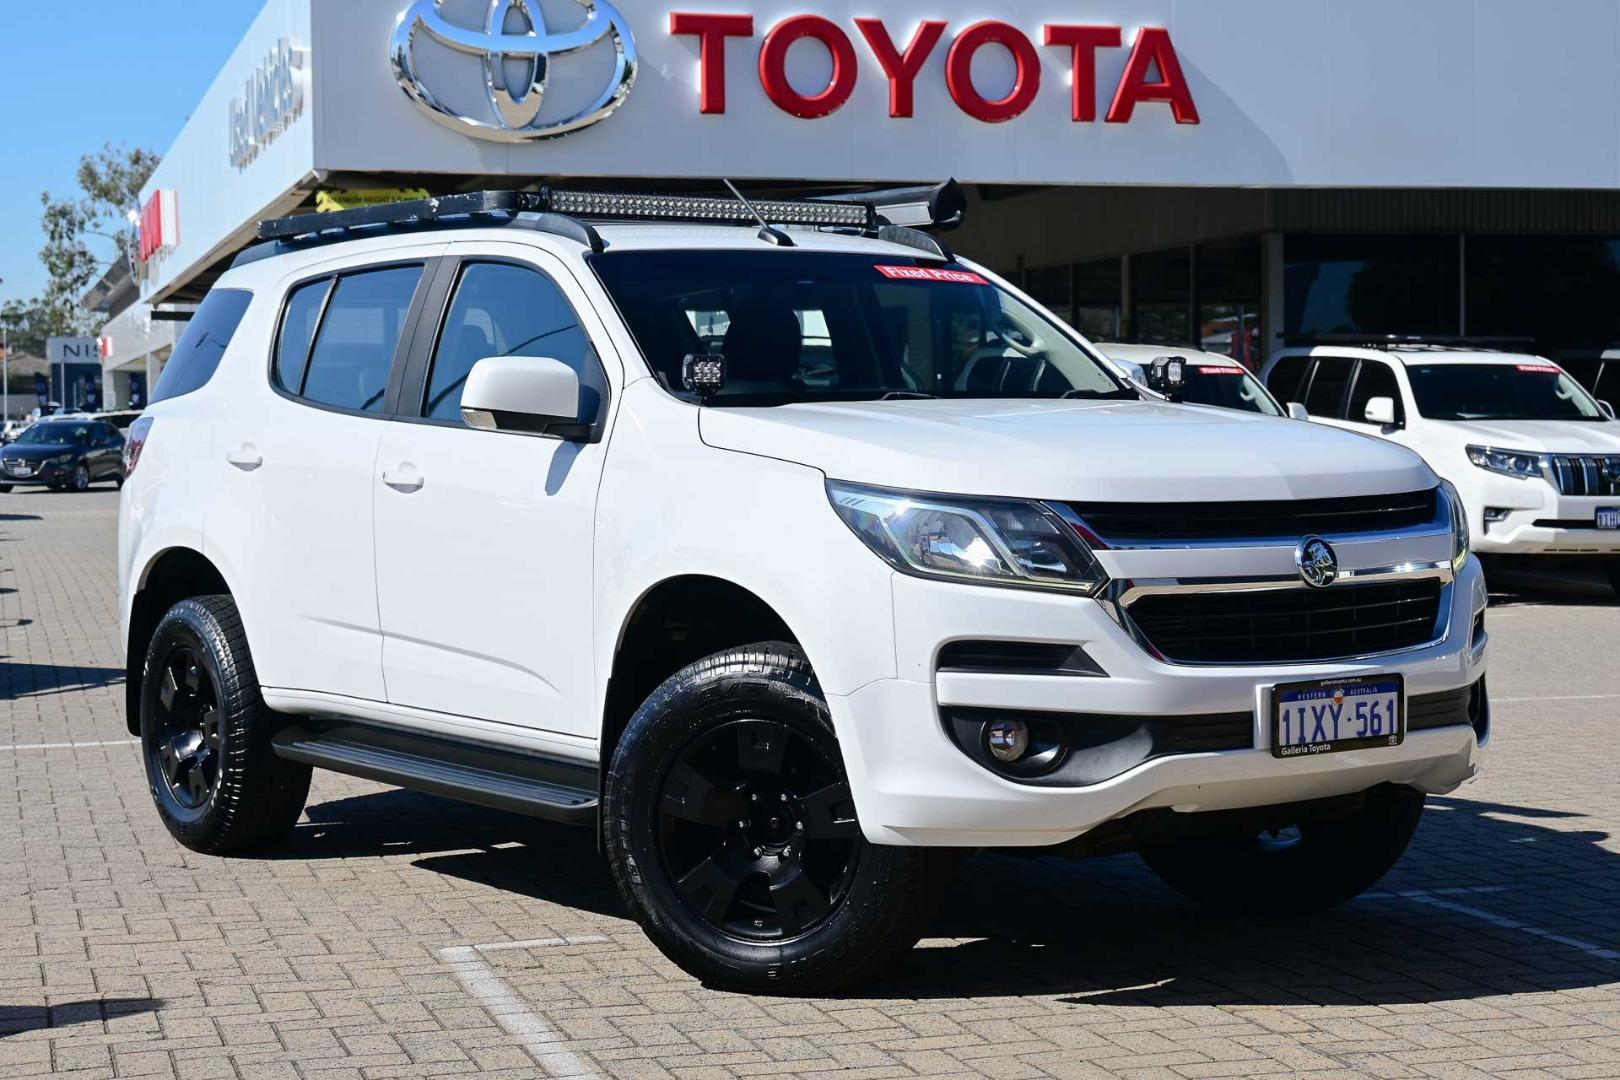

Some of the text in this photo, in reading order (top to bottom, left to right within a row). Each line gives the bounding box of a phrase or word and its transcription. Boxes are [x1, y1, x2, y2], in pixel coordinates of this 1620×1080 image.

[669, 12, 1200, 124] TOYOTA
[882, 266, 976, 282] Fixed Price
[1281, 742, 1331, 756] Galleria Toyota
